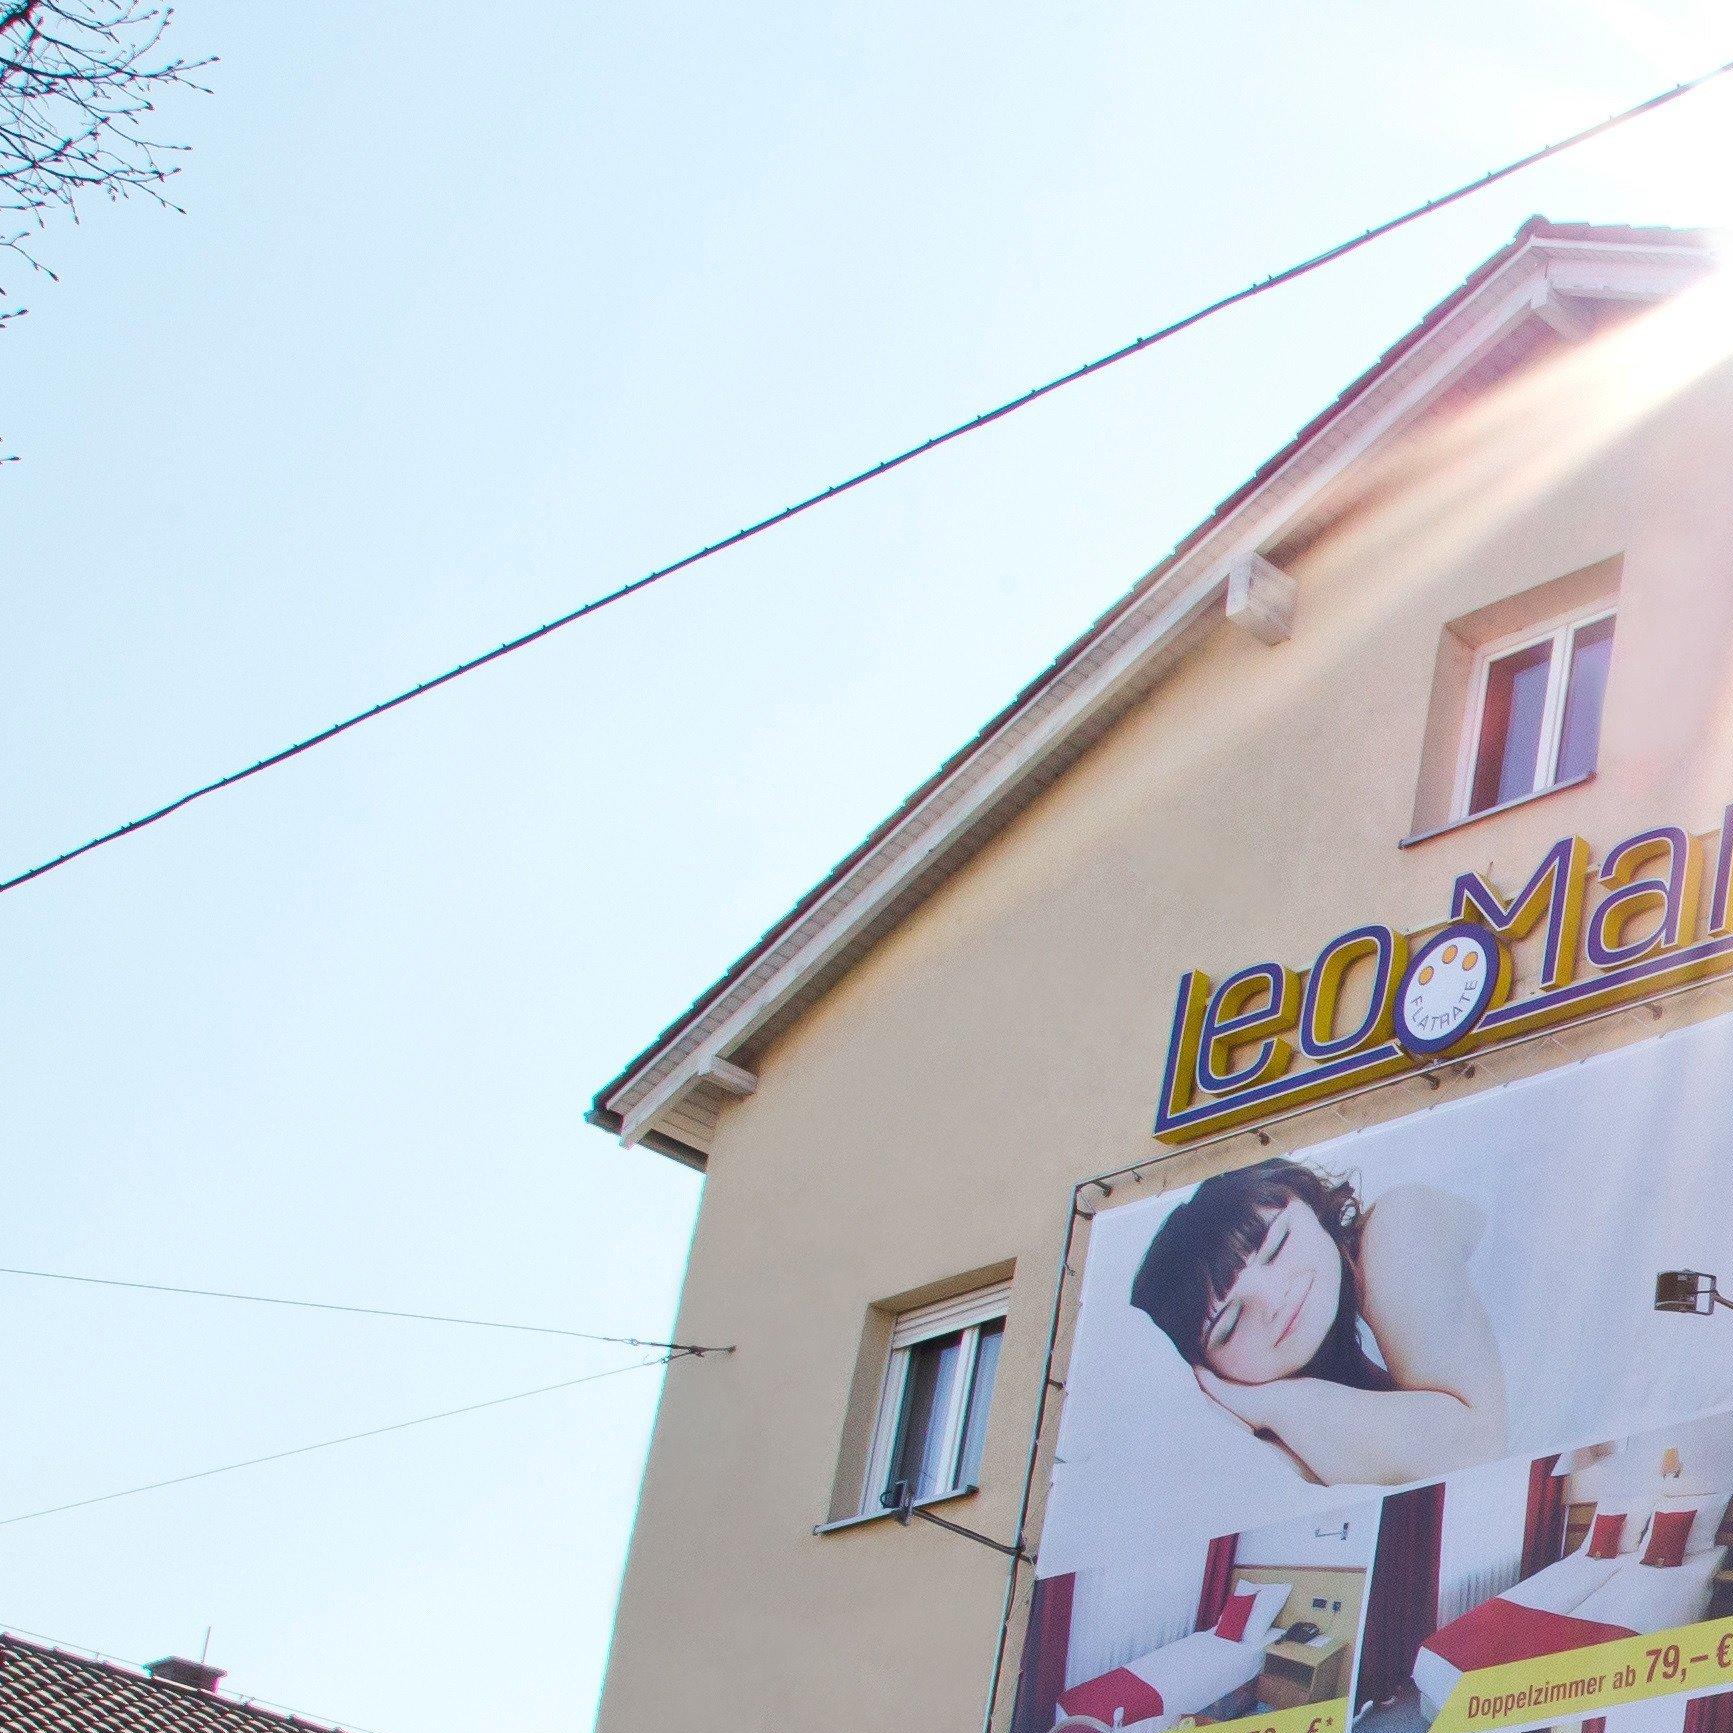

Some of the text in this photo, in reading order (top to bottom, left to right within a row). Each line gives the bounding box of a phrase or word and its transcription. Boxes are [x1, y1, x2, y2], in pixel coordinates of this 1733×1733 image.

[1410, 979, 1479, 1033] FLATRATE
[1468, 1674, 1604, 1719] Doppelzimmer
[1612, 1666, 1636, 1689] ab
